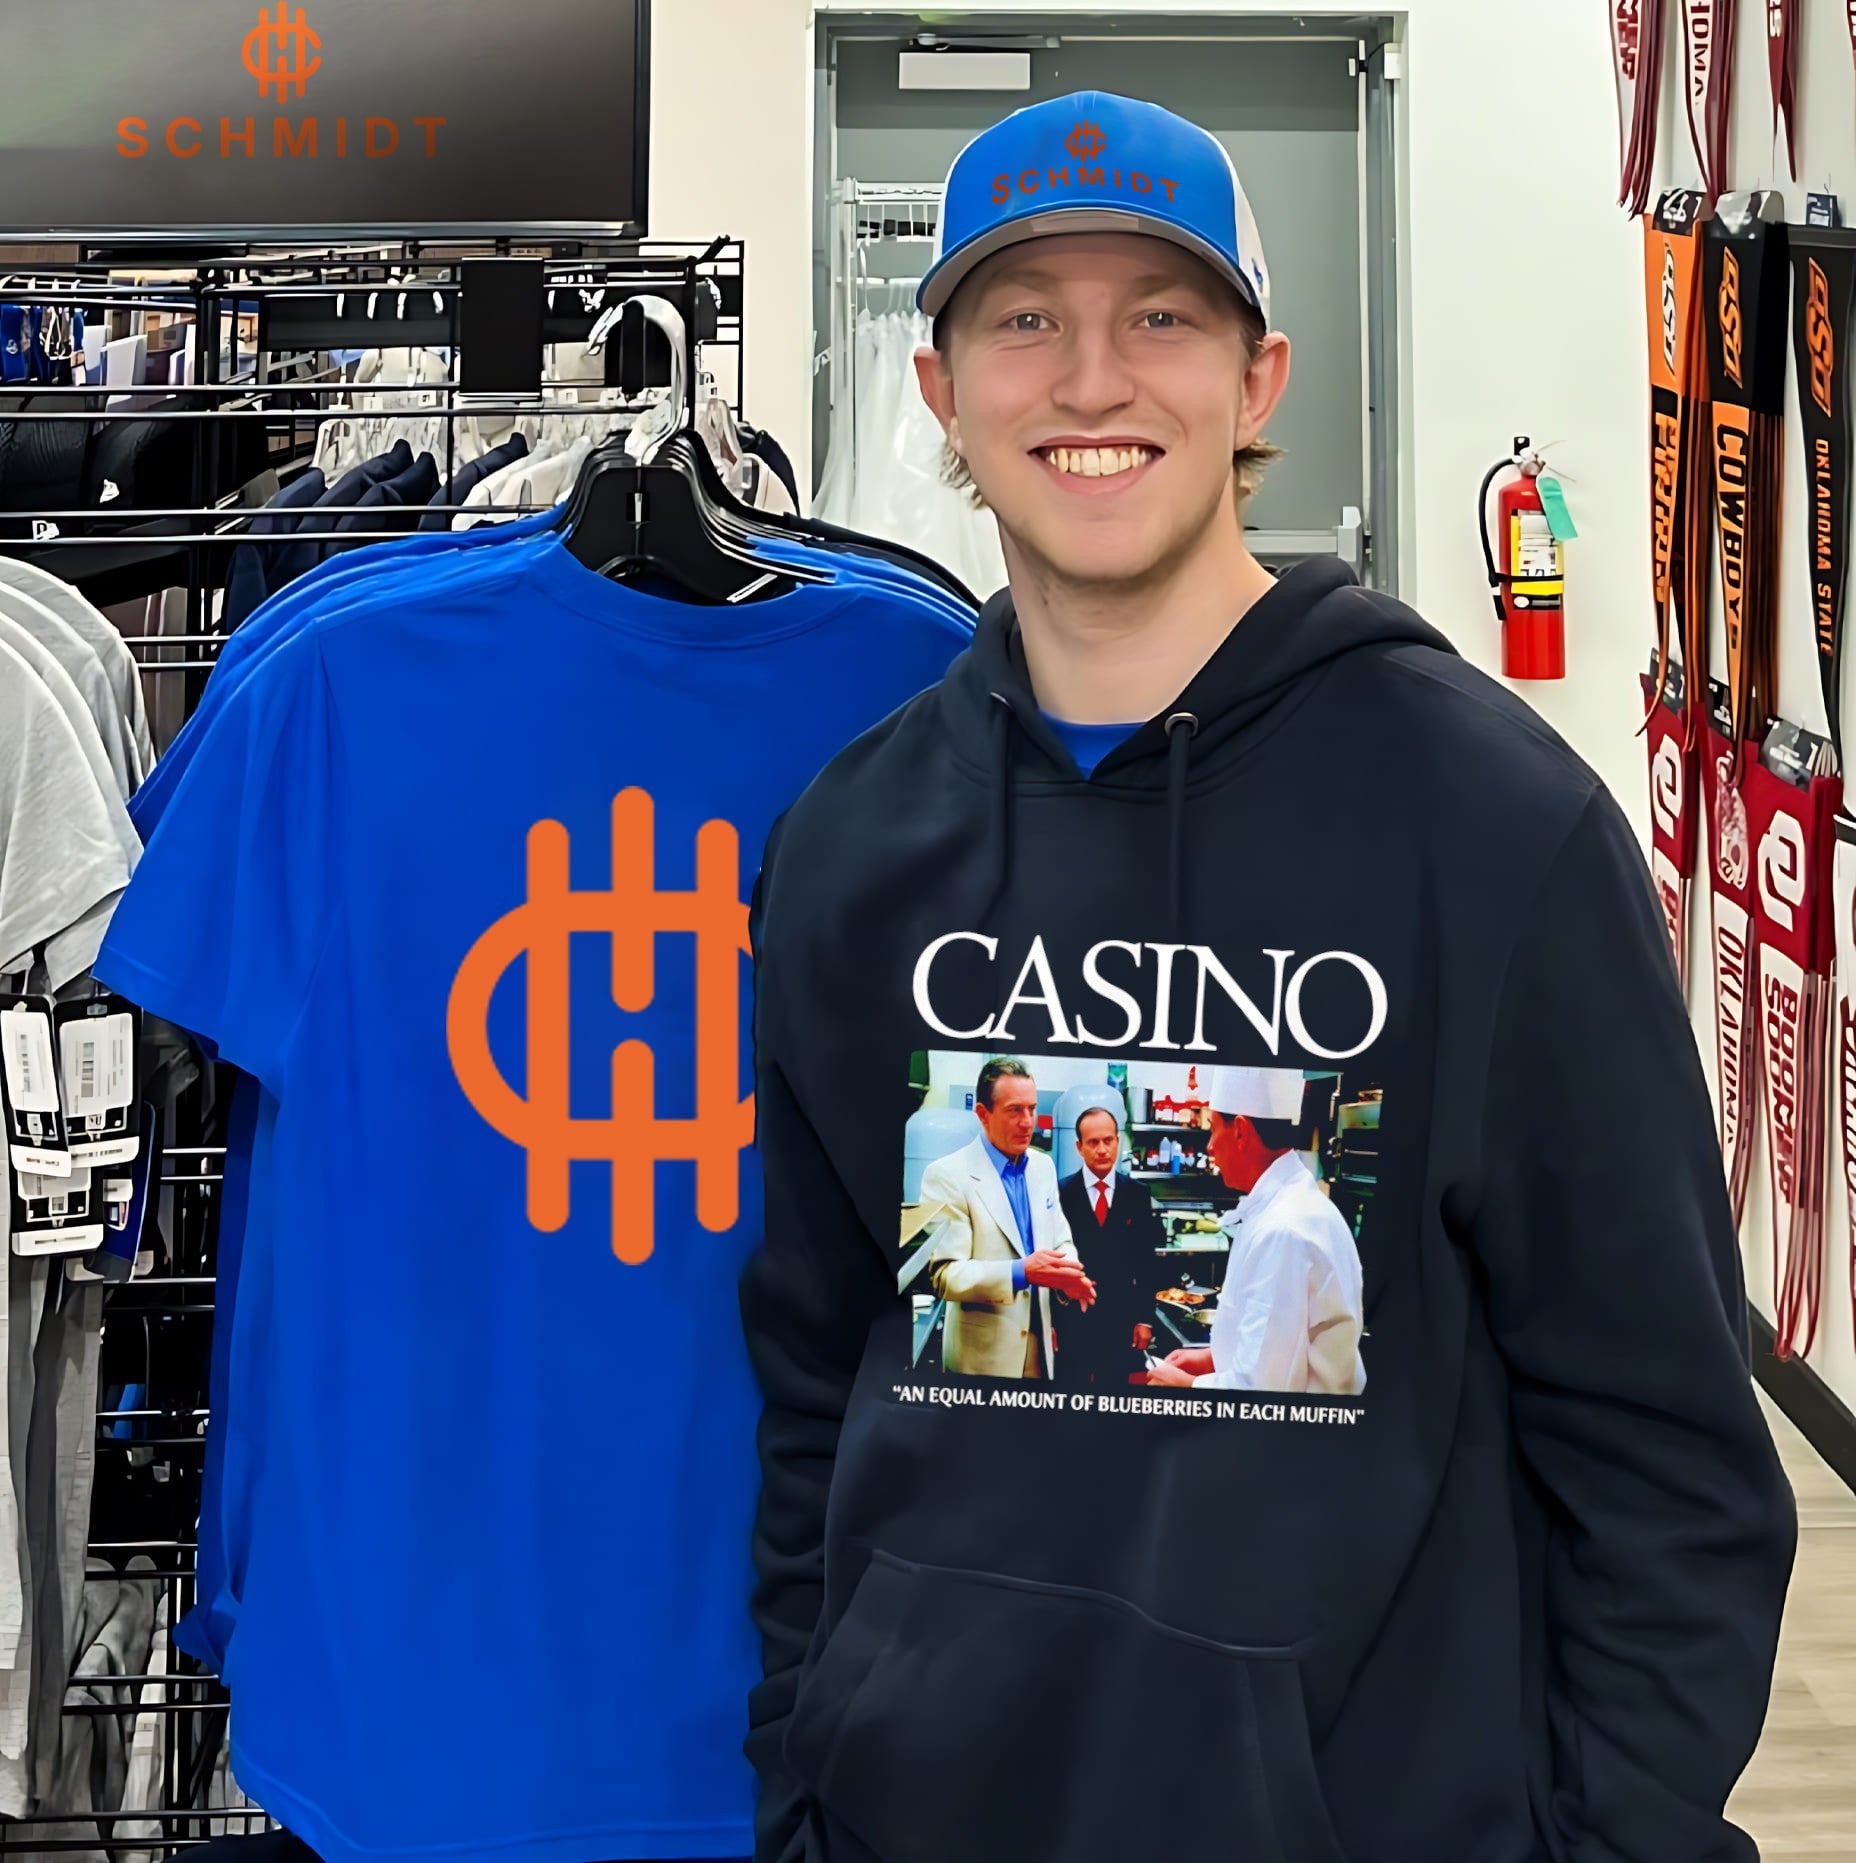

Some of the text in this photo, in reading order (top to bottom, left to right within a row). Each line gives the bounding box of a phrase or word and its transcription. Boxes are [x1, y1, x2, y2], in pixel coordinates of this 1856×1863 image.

[115, 116, 447, 158] SCHMIDT
[991, 166, 1179, 205] SCHMIDT
[912, 931, 1388, 1060] CASINO
[1718, 925, 1745, 1144] OKLAHOMA
[929, 1386, 986, 1407] EQUAL
[989, 1389, 1067, 1410] AMOUNT
[1070, 1394, 1095, 1412] OF
[1097, 1396, 1212, 1418] BLUEBERRIES
[1216, 1401, 1236, 1420] IN
[1240, 1403, 1285, 1421] EACH
